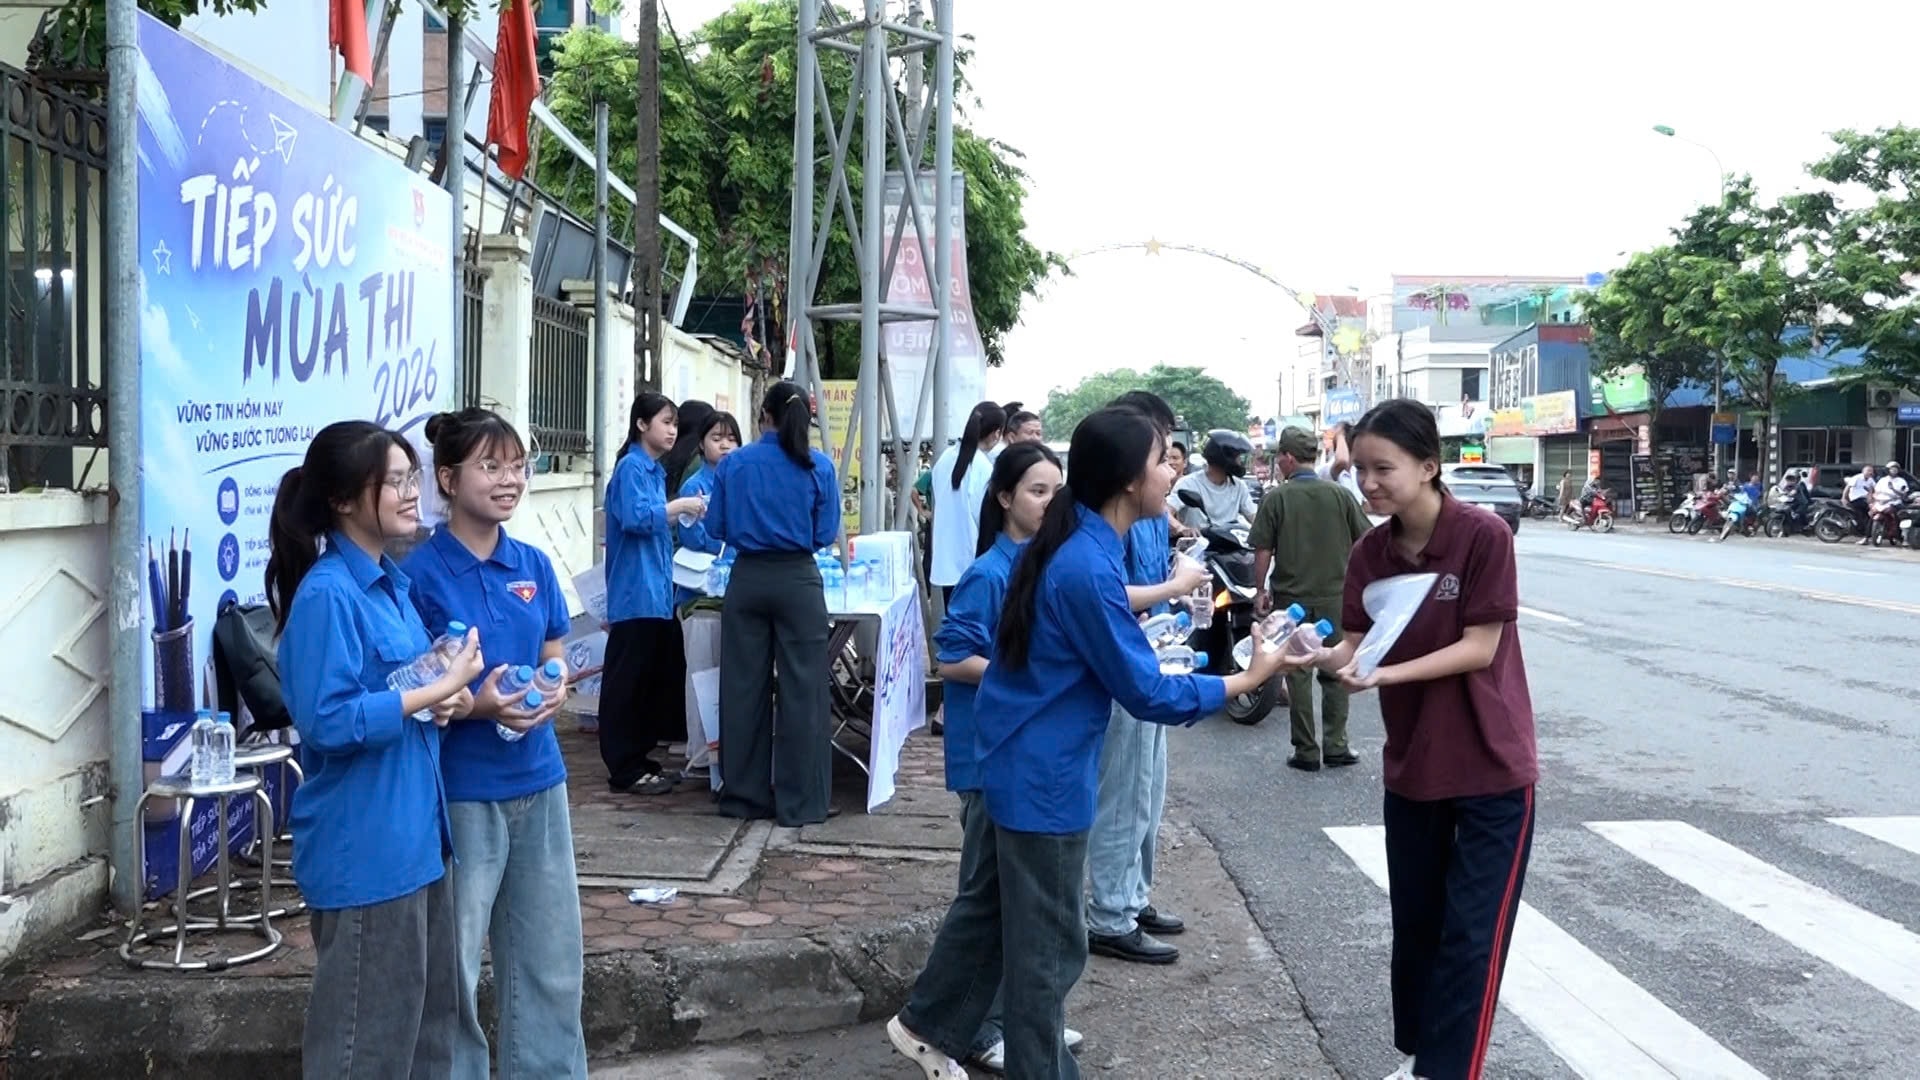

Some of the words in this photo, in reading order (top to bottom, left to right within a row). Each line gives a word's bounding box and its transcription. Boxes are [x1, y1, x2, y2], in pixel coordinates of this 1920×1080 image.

[180, 156, 277, 272] TIẾP
[292, 174, 358, 272] SỨC
[243, 272, 349, 386] MÙA
[359, 270, 414, 367] THI
[177, 400, 211, 423] VỮNG
[216, 403, 233, 421] TIN
[237, 398, 260, 419] HÔM
[264, 401, 284, 418] NAY
[373, 338, 437, 430] 2026
[196, 430, 229, 452] VỮNG
[232, 426, 263, 449] BƯỚC
[265, 426, 298, 445] TƯƠNG
